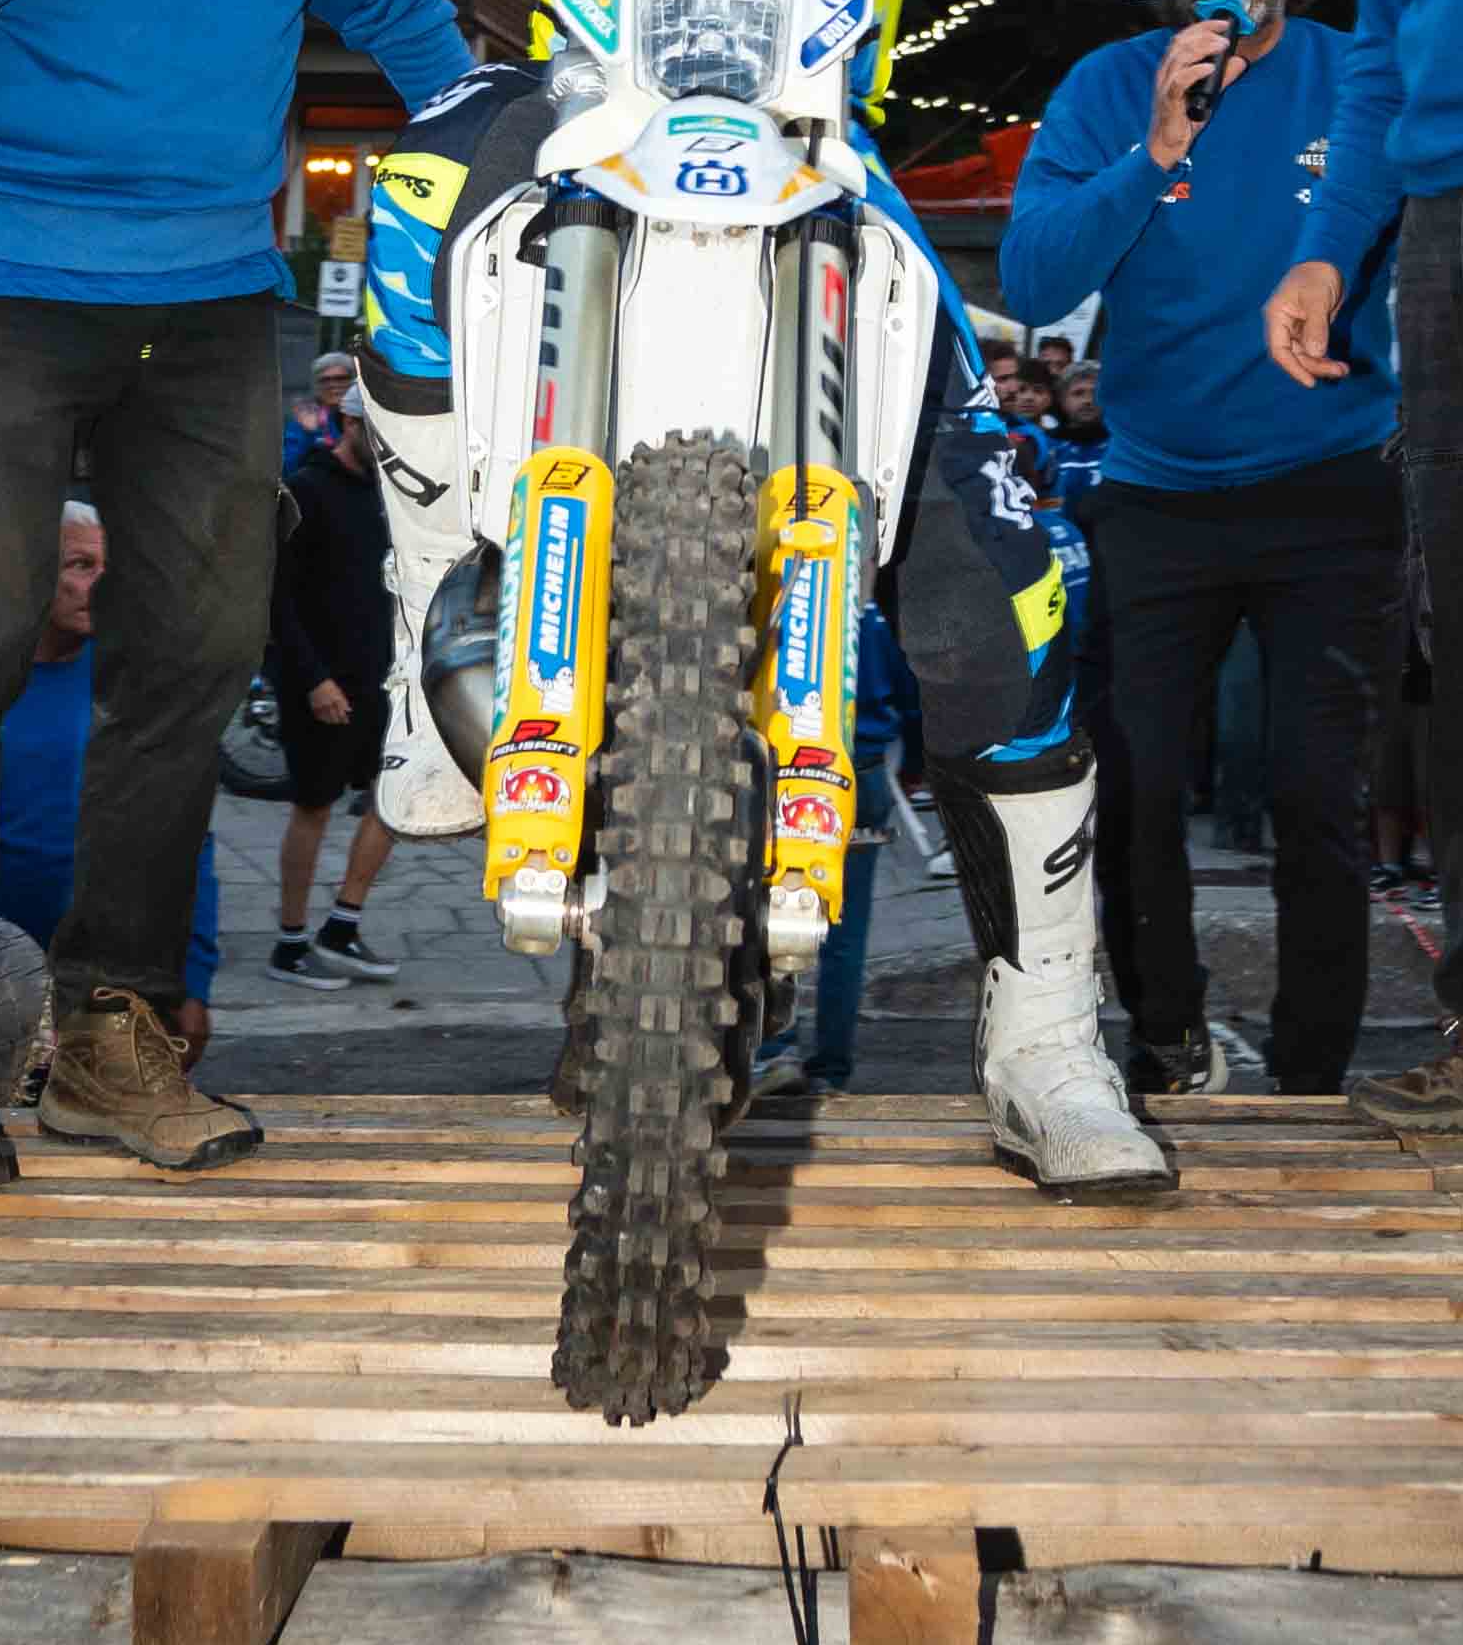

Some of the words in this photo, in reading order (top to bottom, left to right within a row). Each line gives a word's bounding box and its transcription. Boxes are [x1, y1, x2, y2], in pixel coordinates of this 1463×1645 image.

[819, 11, 858, 48] BOLT
[538, 503, 571, 656] MICHELIN
[785, 558, 813, 680] MICHEL
[778, 765, 850, 789] OLISPORT
